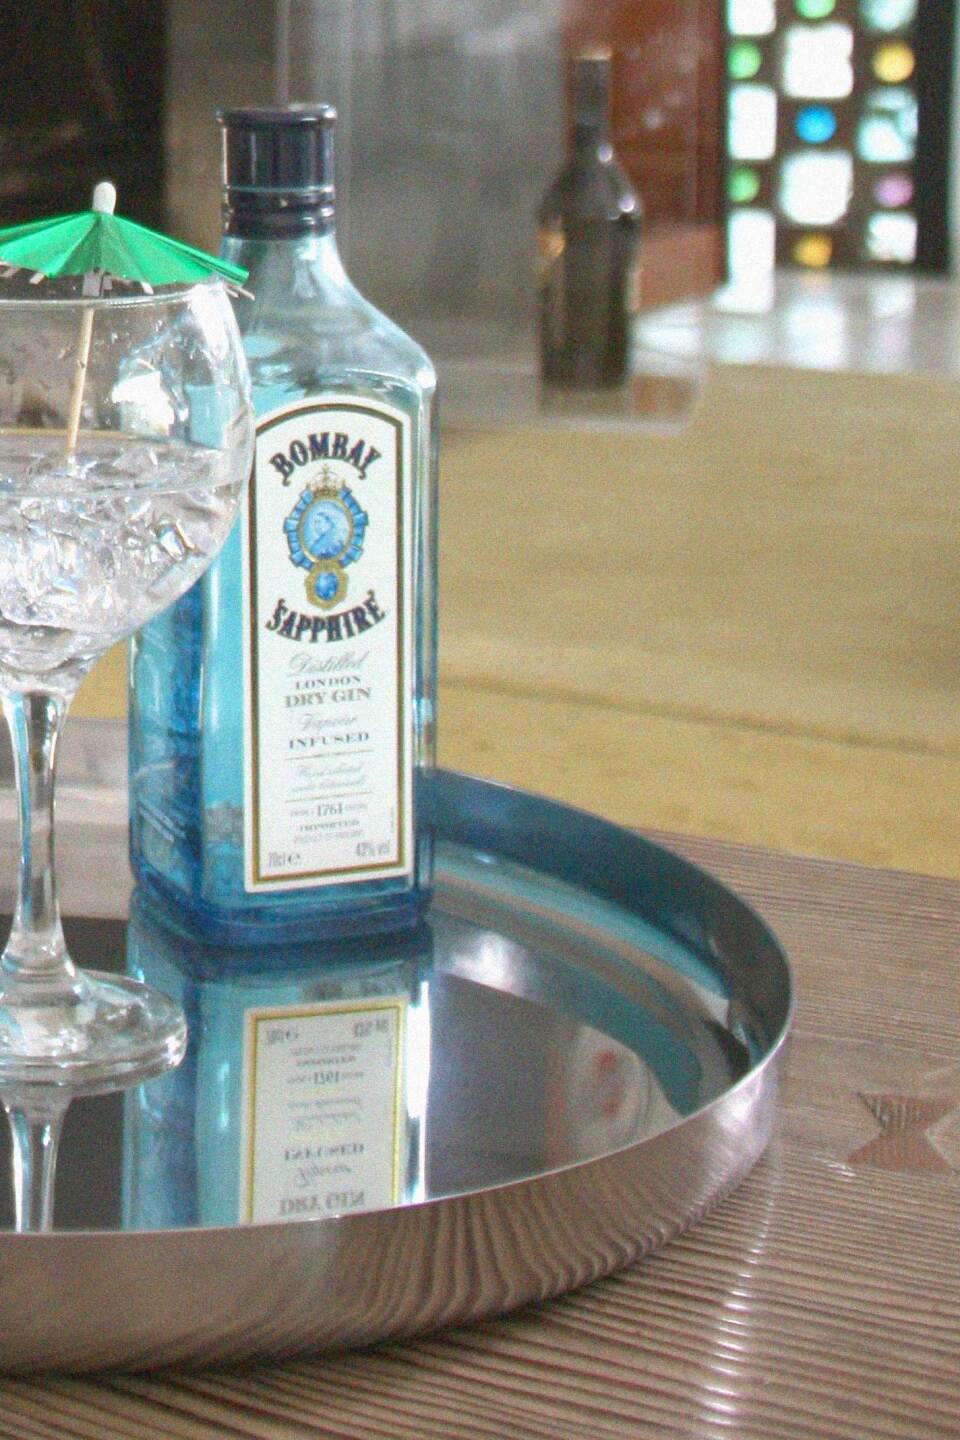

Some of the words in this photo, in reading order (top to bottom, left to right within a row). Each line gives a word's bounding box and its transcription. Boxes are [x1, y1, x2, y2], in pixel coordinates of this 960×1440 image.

[269, 431, 382, 487] BOMBAY
[264, 588, 386, 644] SAPPHIRE
[295, 675, 362, 690] LONDON
[284, 691, 327, 709] DRY
[331, 686, 372, 703] GIN
[288, 731, 370, 750] INFUSED
[316, 802, 343, 817] 1761
